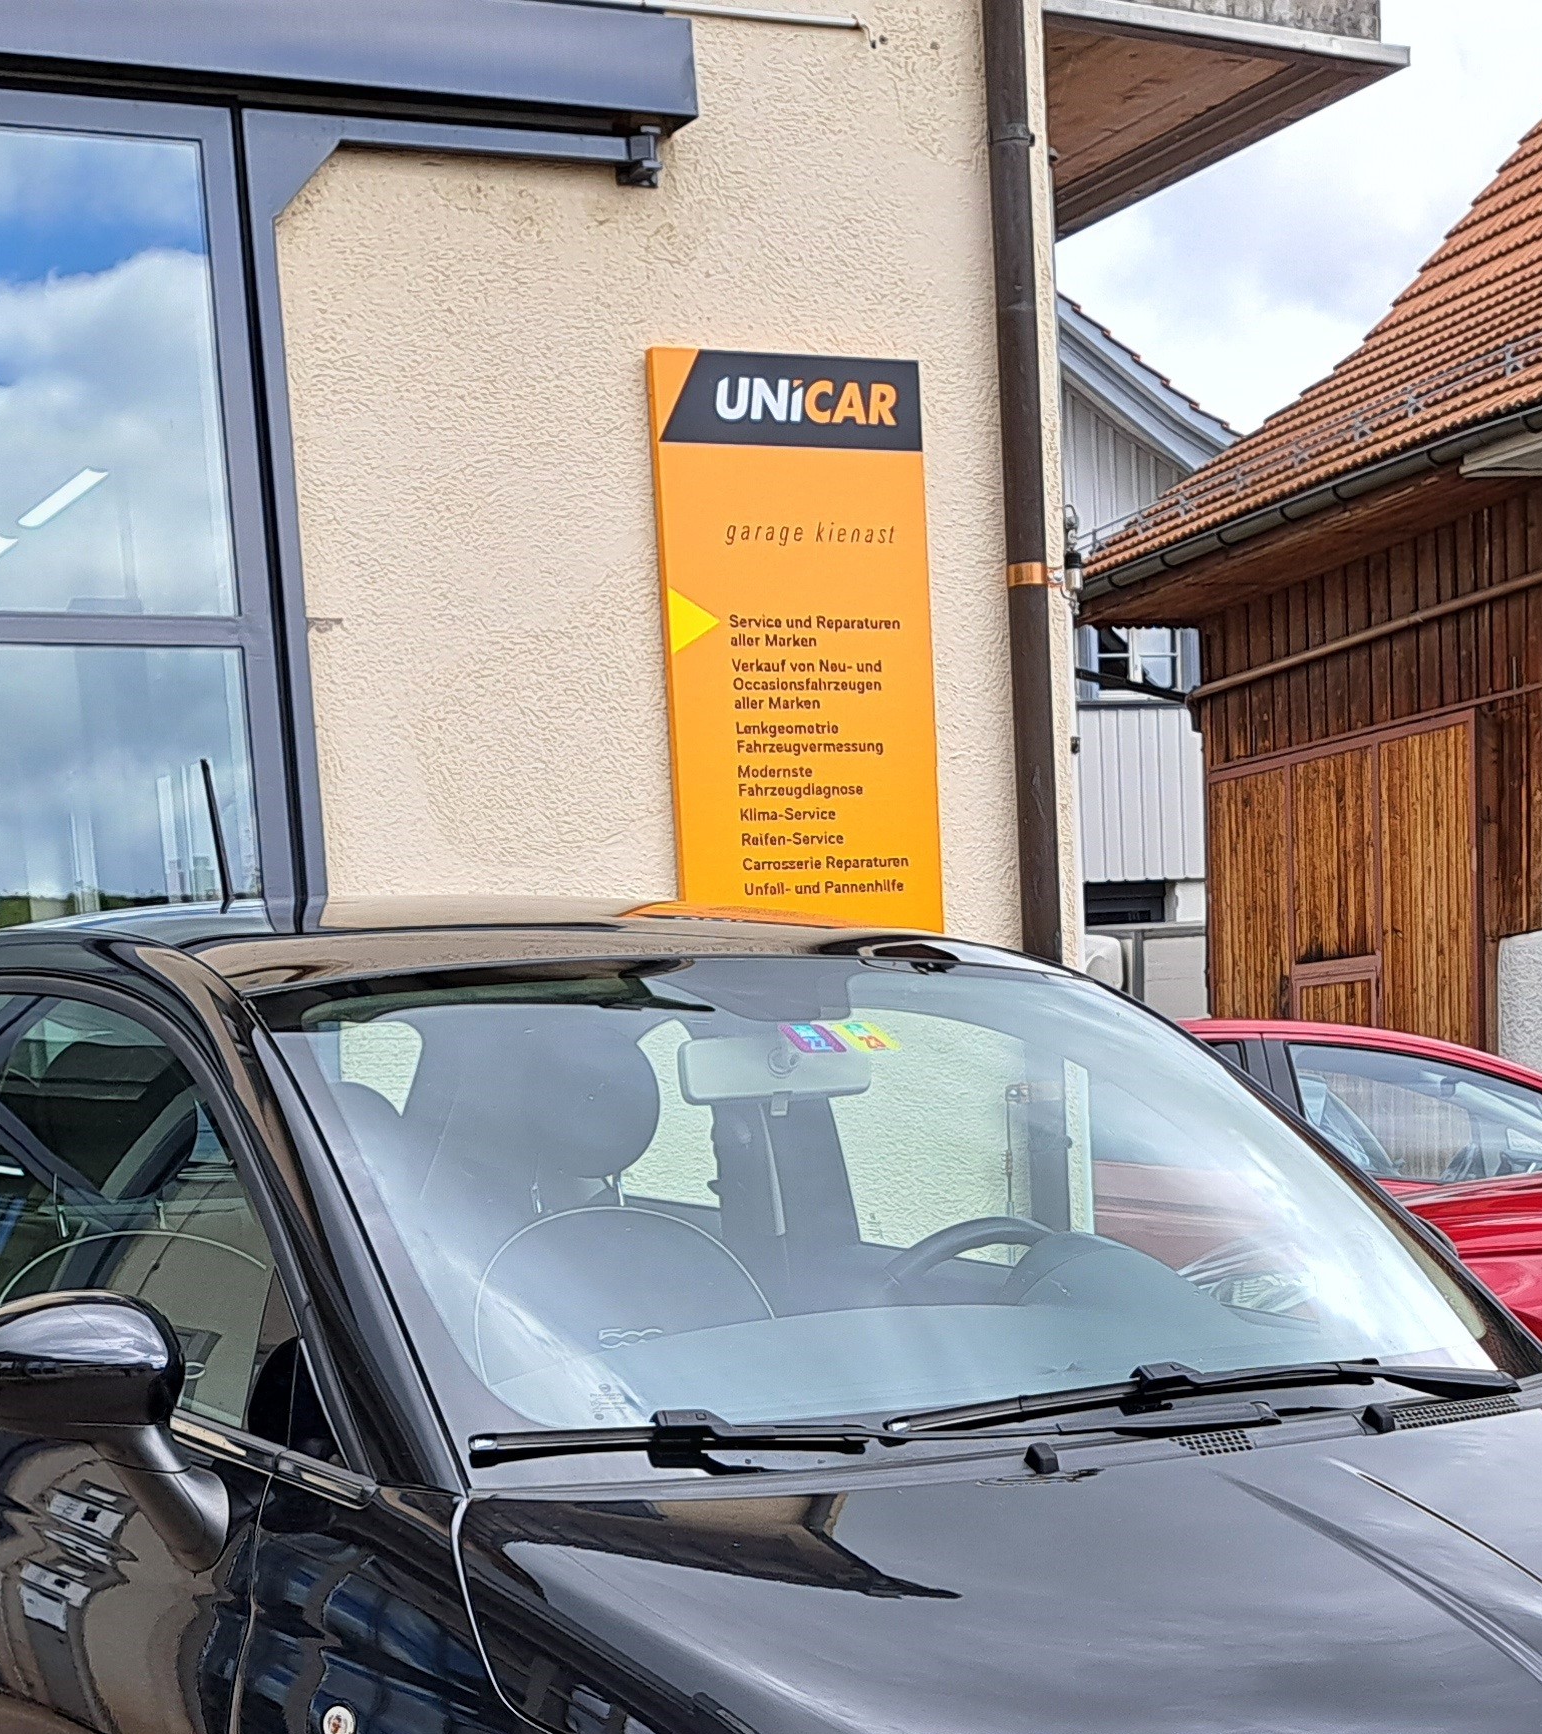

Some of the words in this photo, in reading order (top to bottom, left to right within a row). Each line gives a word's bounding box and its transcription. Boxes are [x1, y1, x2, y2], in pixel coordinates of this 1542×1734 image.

[724, 523, 804, 547] garage
[815, 521, 896, 544] kienast
[729, 613, 782, 629] Service
[785, 615, 812, 629] und
[816, 615, 901, 632] Reparaturen
[730, 634, 761, 647] aller
[765, 634, 817, 647] Marken
[731, 658, 786, 673] Verkauf
[790, 661, 815, 673] von
[819, 659, 853, 673] Neu-
[856, 659, 882, 673] und
[733, 677, 882, 694] Occasionsfahrzeugen
[734, 696, 764, 710] aller
[768, 696, 821, 710] Marken
[735, 721, 839, 738] Lenkgeometrie
[736, 740, 884, 756] Fahrzeugvermessung
[737, 764, 813, 779] Modernste
[738, 783, 863, 799] Fahrzeugdiagnose
[739, 807, 837, 822] Klima-Service
[741, 831, 844, 846] Reifen-Service
[742, 856, 822, 871] Carrosserie
[825, 855, 909, 872] Reparaturen
[744, 881, 791, 896] Unfall-
[794, 881, 821, 895] und
[824, 878, 905, 894] Pannenhilfe
